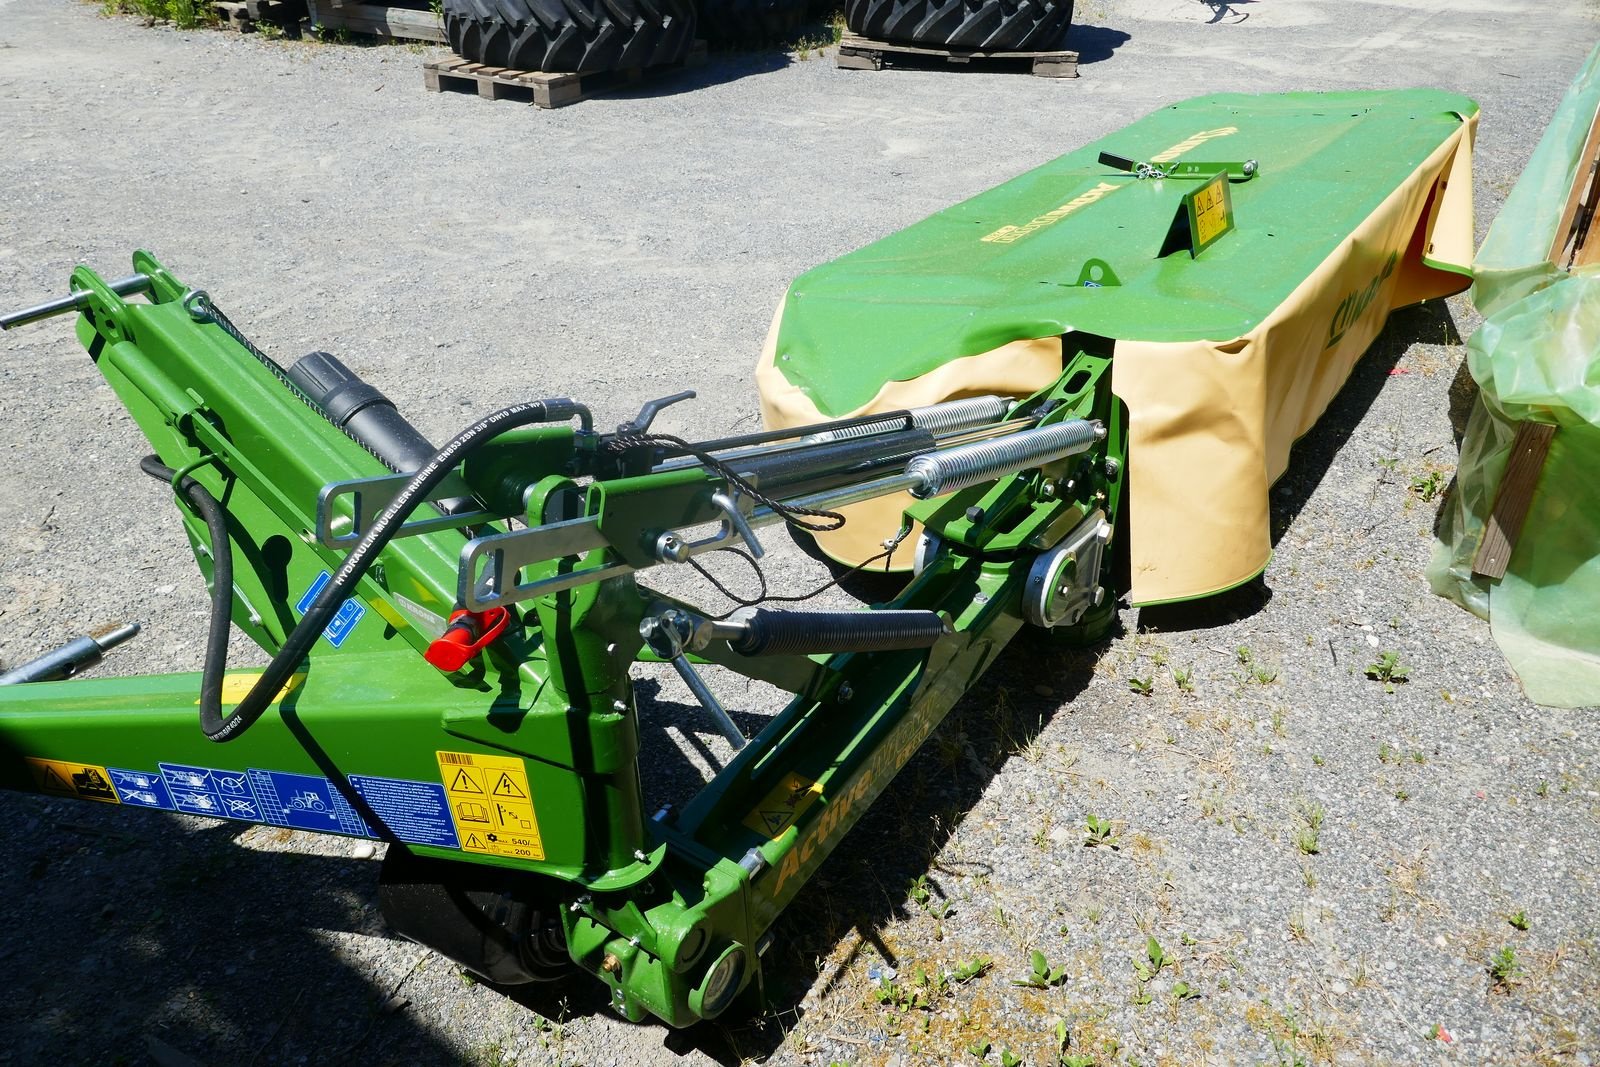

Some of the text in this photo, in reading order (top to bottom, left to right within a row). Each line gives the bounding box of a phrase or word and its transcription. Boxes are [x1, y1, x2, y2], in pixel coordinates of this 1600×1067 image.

[335, 531, 378, 586] HYDRAULIK
[375, 490, 412, 533] MUELLER
[408, 462, 438, 492] RHEINE
[437, 440, 462, 463] EN853
[488, 411, 510, 423] DN10
[510, 404, 530, 415] MAX.
[515, 848, 531, 856] 200
